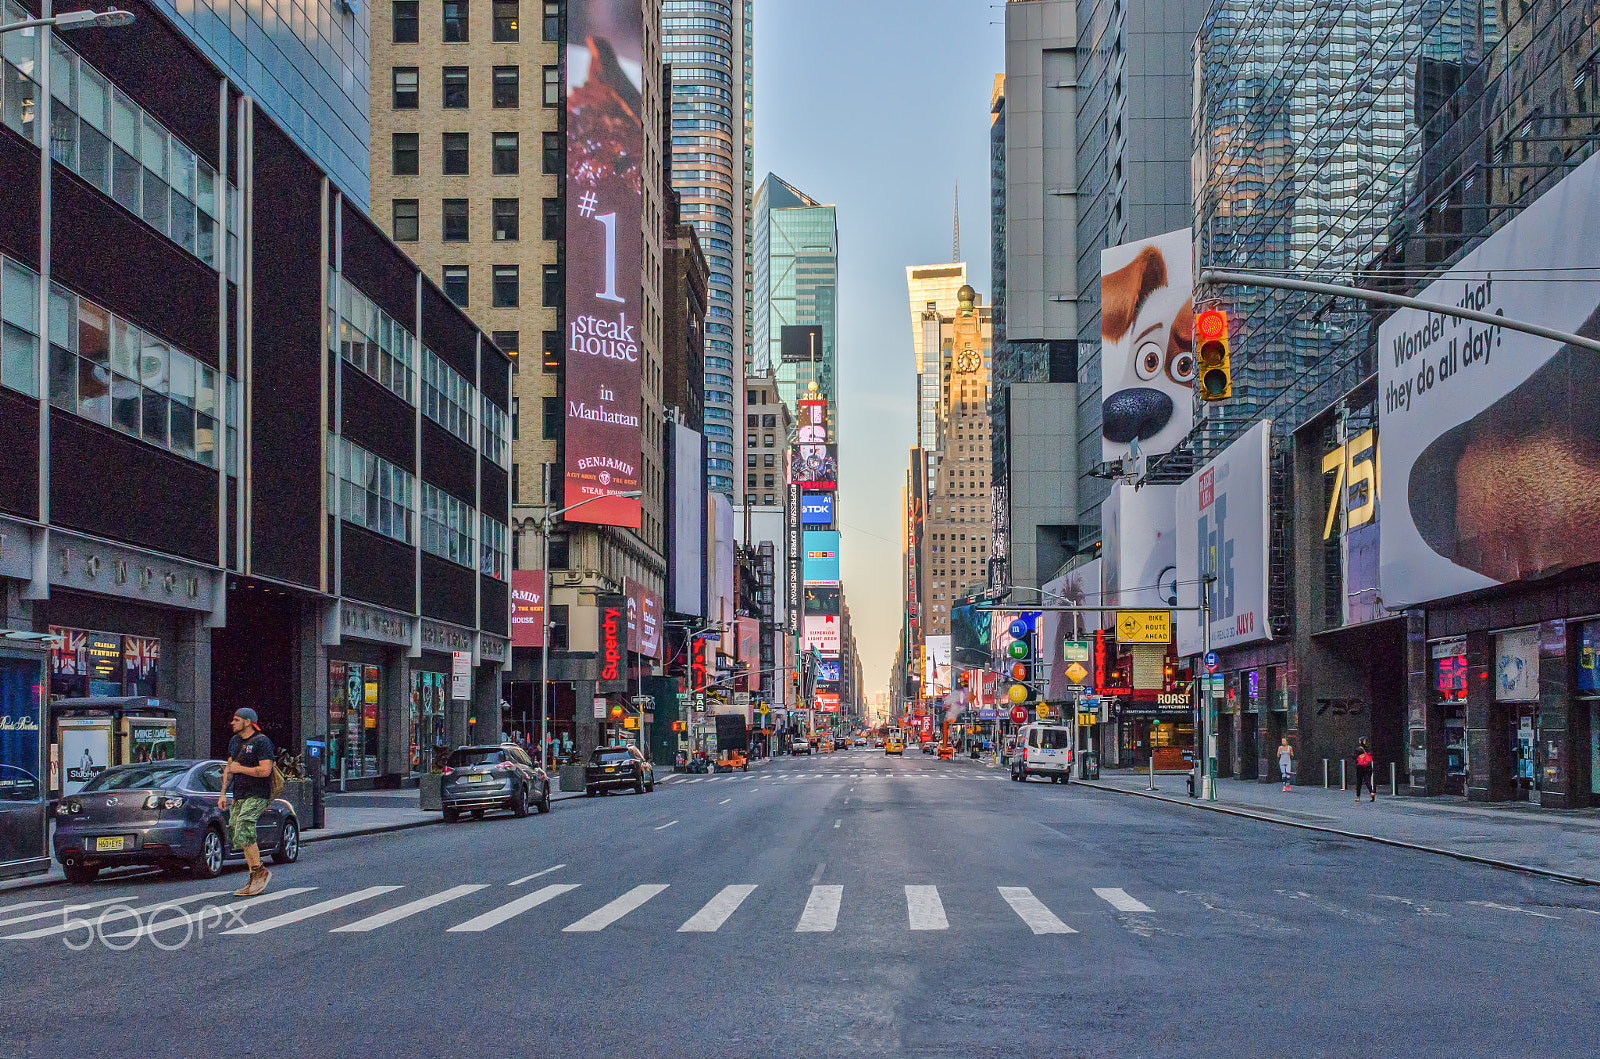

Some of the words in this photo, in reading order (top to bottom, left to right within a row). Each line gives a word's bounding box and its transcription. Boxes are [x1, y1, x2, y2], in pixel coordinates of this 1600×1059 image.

[577, 190, 625, 303] #1
[576, 312, 635, 343] steak
[1393, 311, 1447, 368] Wonder
[1452, 272, 1493, 328] what
[569, 321, 638, 362] house
[1386, 374, 1413, 415] they
[1416, 358, 1435, 396] do
[1438, 344, 1457, 382] all
[1463, 307, 1504, 367] day?
[600, 384, 614, 402] in
[803, 392, 822, 400] 2016
[568, 401, 639, 427] Manhattan
[577, 456, 634, 476] BENJAMIN
[581, 486, 604, 495] STEAK
[791, 480, 837, 489] TOSHIBA
[1322, 428, 1381, 540] 75
[806, 505, 829, 513] TDK
[511, 589, 541, 604] AMIN
[511, 616, 534, 624] HOUSE
[1236, 612, 1249, 636] JULY
[1250, 611, 1254, 633] 8
[696, 693, 704, 711] BAR
[1157, 693, 1190, 704] ROAST
[311, 747, 318, 756] P
